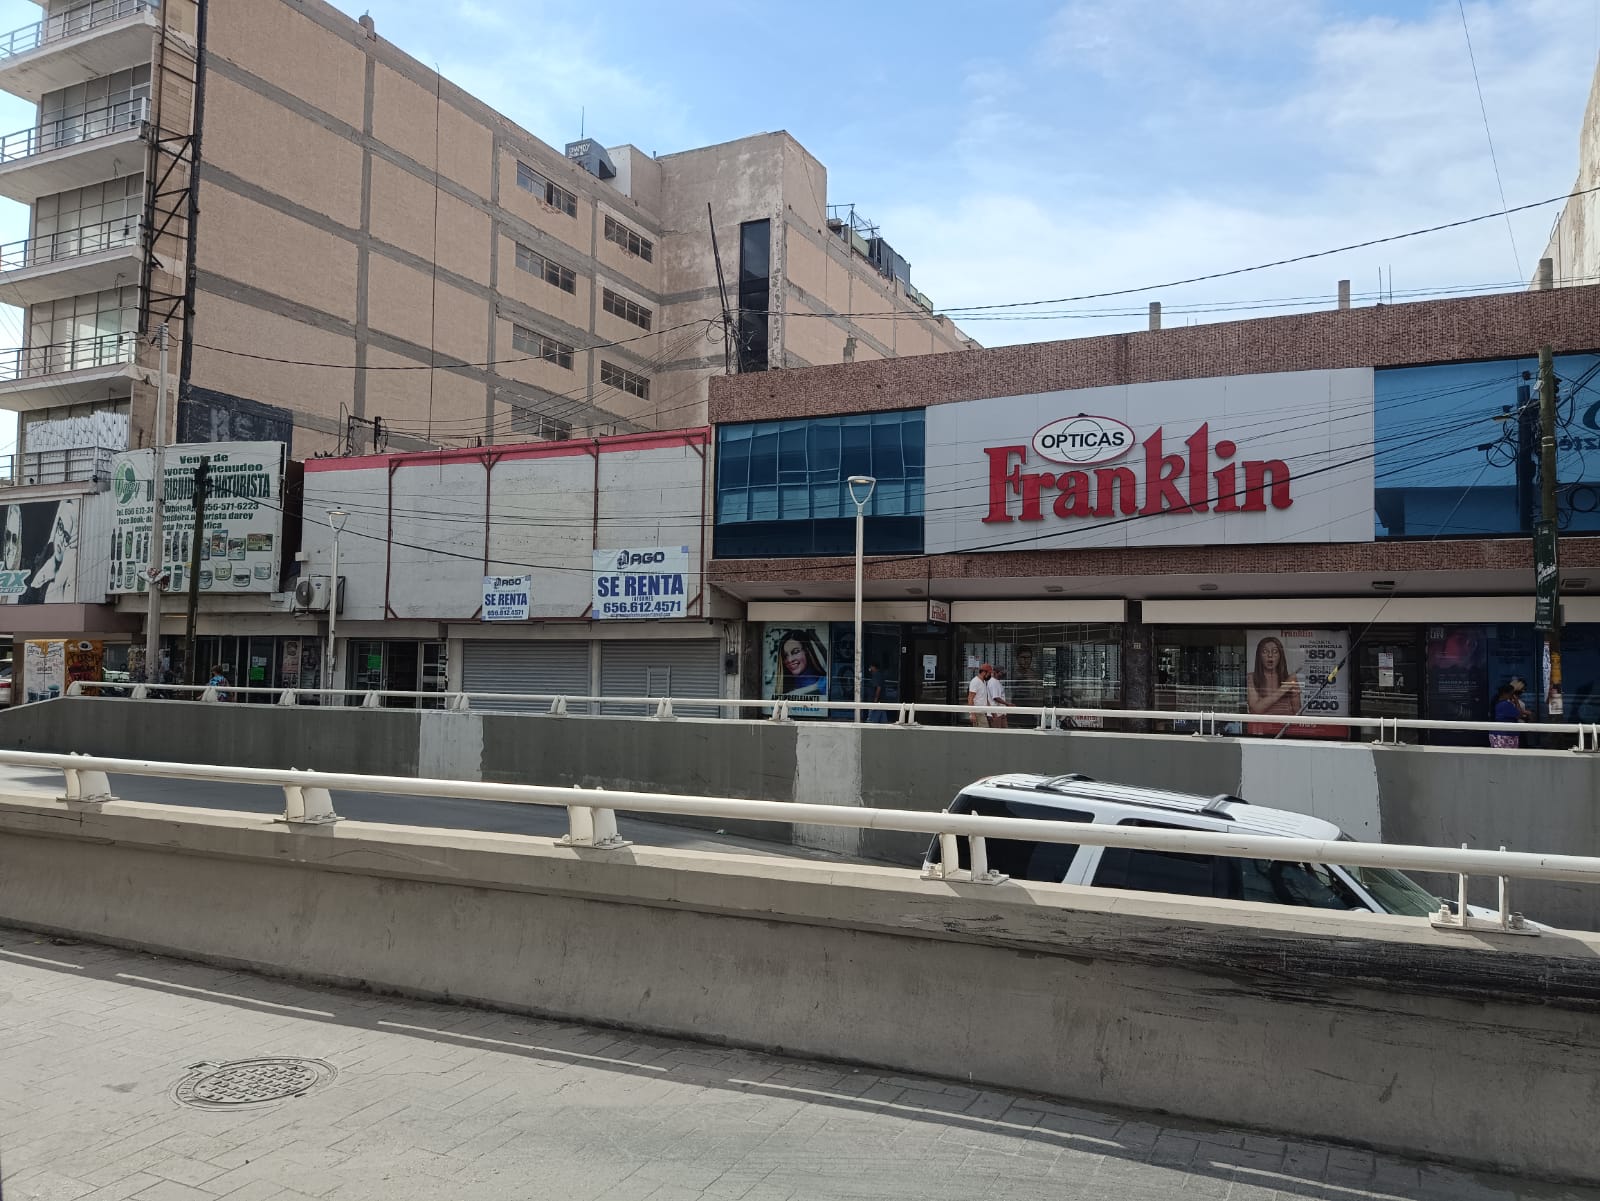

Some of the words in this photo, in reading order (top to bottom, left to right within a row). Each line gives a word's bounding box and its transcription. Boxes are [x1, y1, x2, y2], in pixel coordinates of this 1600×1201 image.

[1041, 431, 1126, 450] OPTICAS
[213, 453, 229, 463] de
[981, 422, 1294, 524] Franklin
[147, 474, 213, 502] DIRIBUIDA
[214, 472, 271, 499] NATURISTA
[228, 511, 254, 521] darey
[629, 551, 665, 565] AGO
[501, 578, 522, 587] AGO
[597, 576, 620, 598] SE
[624, 574, 684, 597] RENTA
[485, 593, 496, 606] SE
[498, 592, 528, 606] RENTA
[603, 601, 681, 613] 656.612.4571
